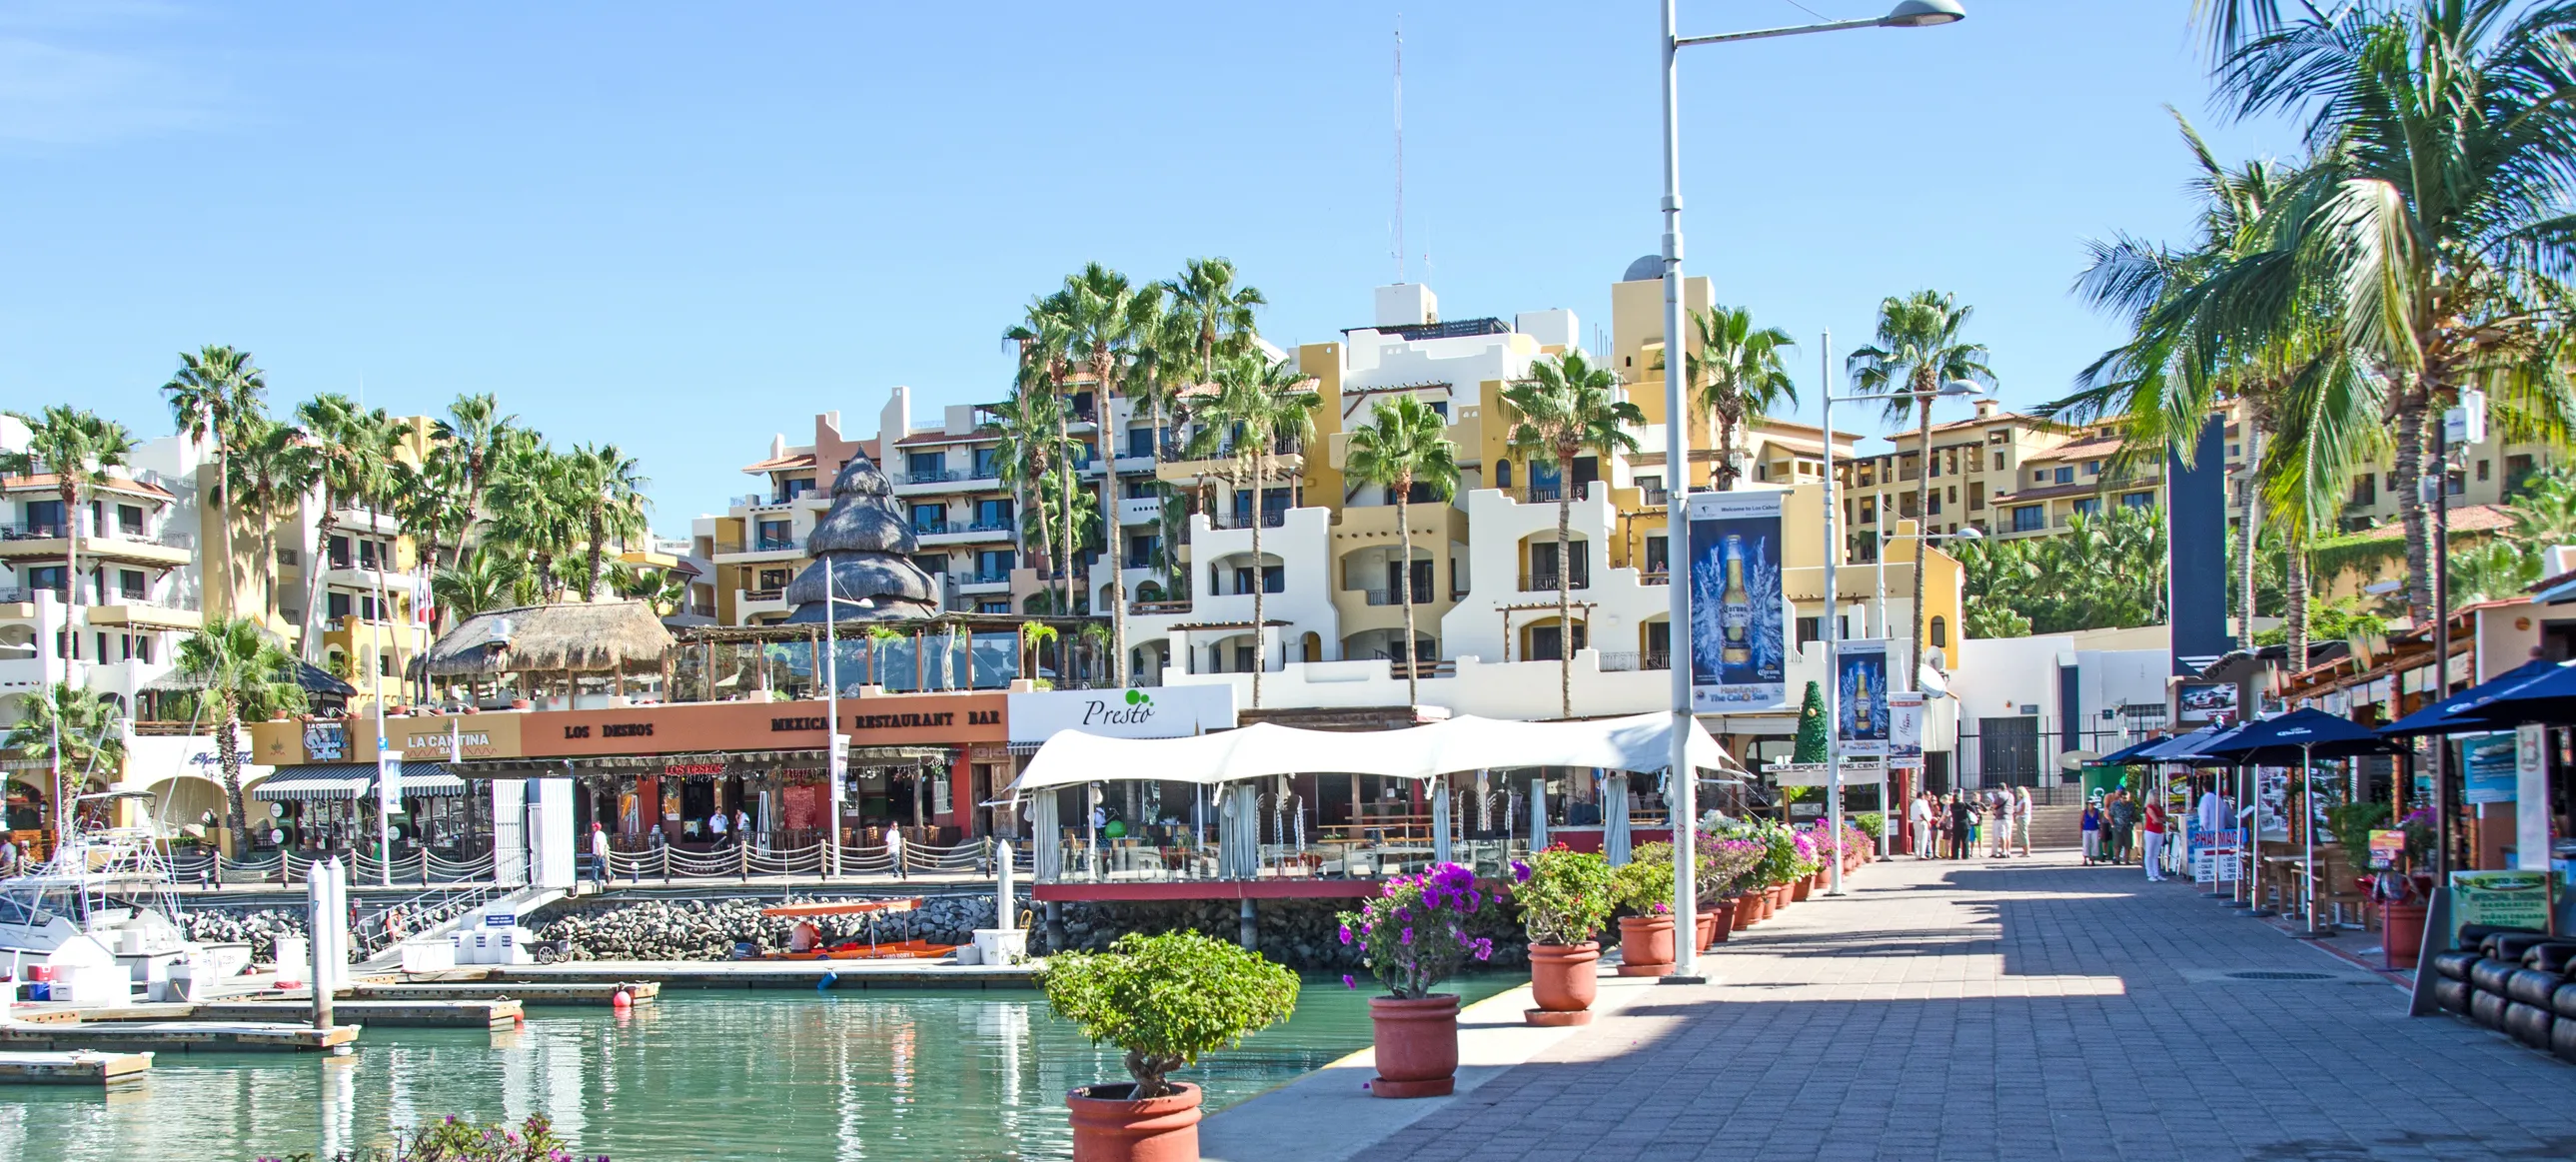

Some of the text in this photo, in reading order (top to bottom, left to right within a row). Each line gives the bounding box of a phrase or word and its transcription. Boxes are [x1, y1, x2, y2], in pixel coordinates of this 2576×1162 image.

[1083, 700, 1155, 725] Presto
[771, 710, 1001, 732] MEXICA RESTAURANT BAR
[565, 723, 653, 739] LOS DESEOS
[408, 733, 491, 748] LA CANTINA
[665, 763, 724, 775] LOS DESEOS
